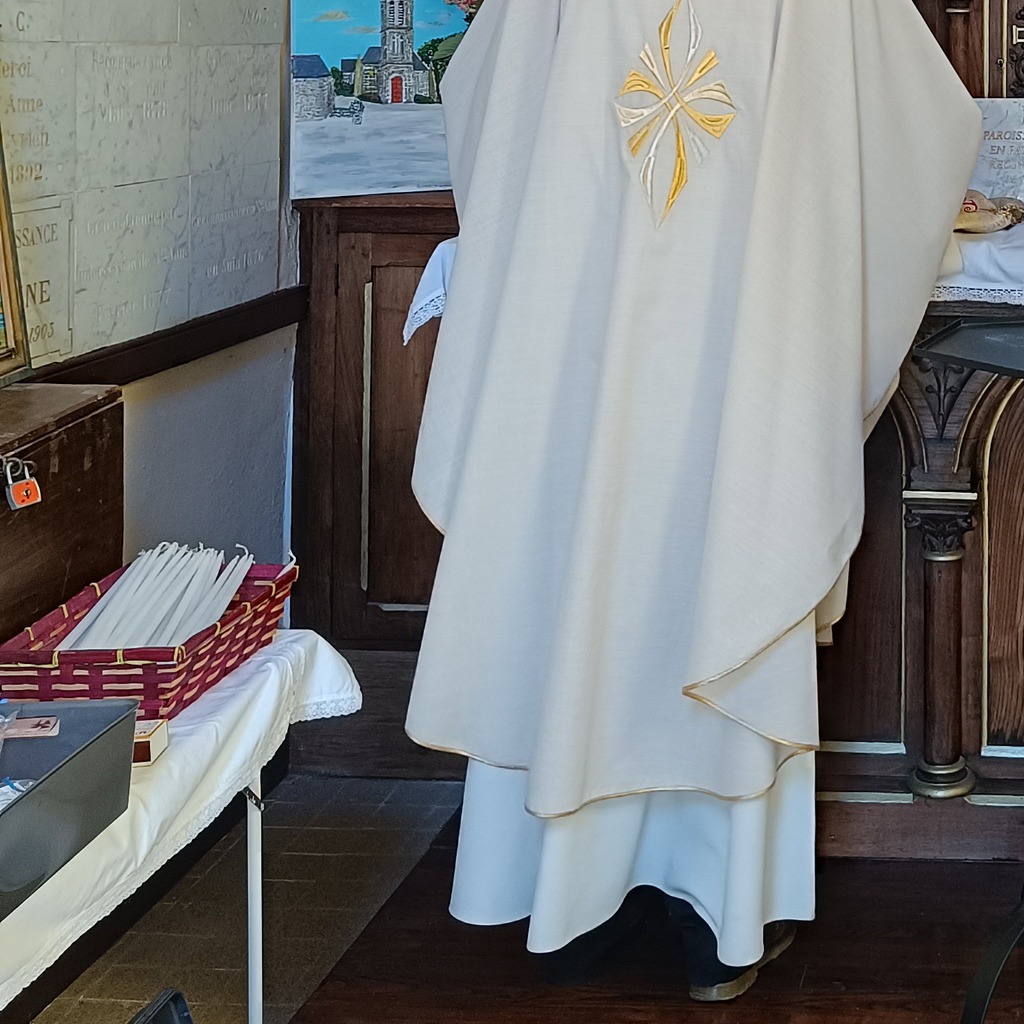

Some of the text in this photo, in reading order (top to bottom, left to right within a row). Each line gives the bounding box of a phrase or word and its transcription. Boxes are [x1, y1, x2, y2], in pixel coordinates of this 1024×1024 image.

[0, 56, 32, 78] erci
[989, 145, 1005, 155] EN
[15, 223, 59, 249] SSANCE
[25, 279, 51, 308] NE
